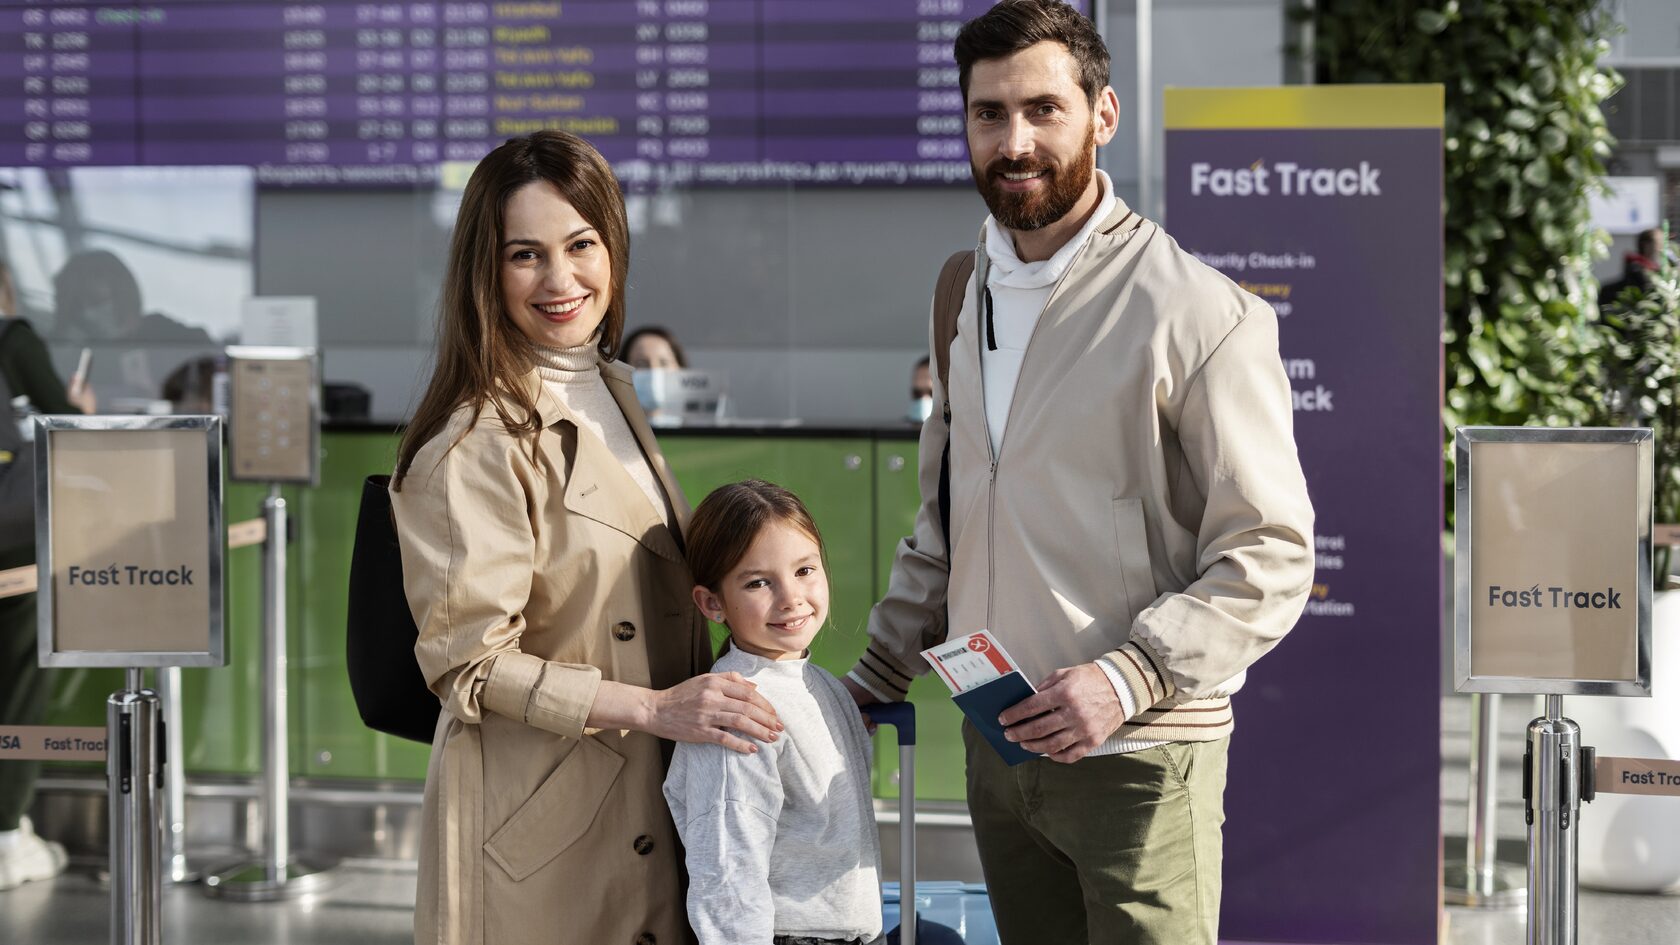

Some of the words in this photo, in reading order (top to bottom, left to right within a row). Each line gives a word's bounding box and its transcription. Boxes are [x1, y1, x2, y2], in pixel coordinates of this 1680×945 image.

[1191, 160, 1270, 196] Fast
[1274, 161, 1381, 196] Track
[1249, 251, 1316, 269] Check-in
[68, 563, 120, 586] Fast
[124, 564, 193, 586] Track
[1489, 583, 1543, 608] Fast
[1547, 586, 1622, 609] Track
[44, 737, 73, 751] Fast
[1622, 770, 1655, 785] Fast
